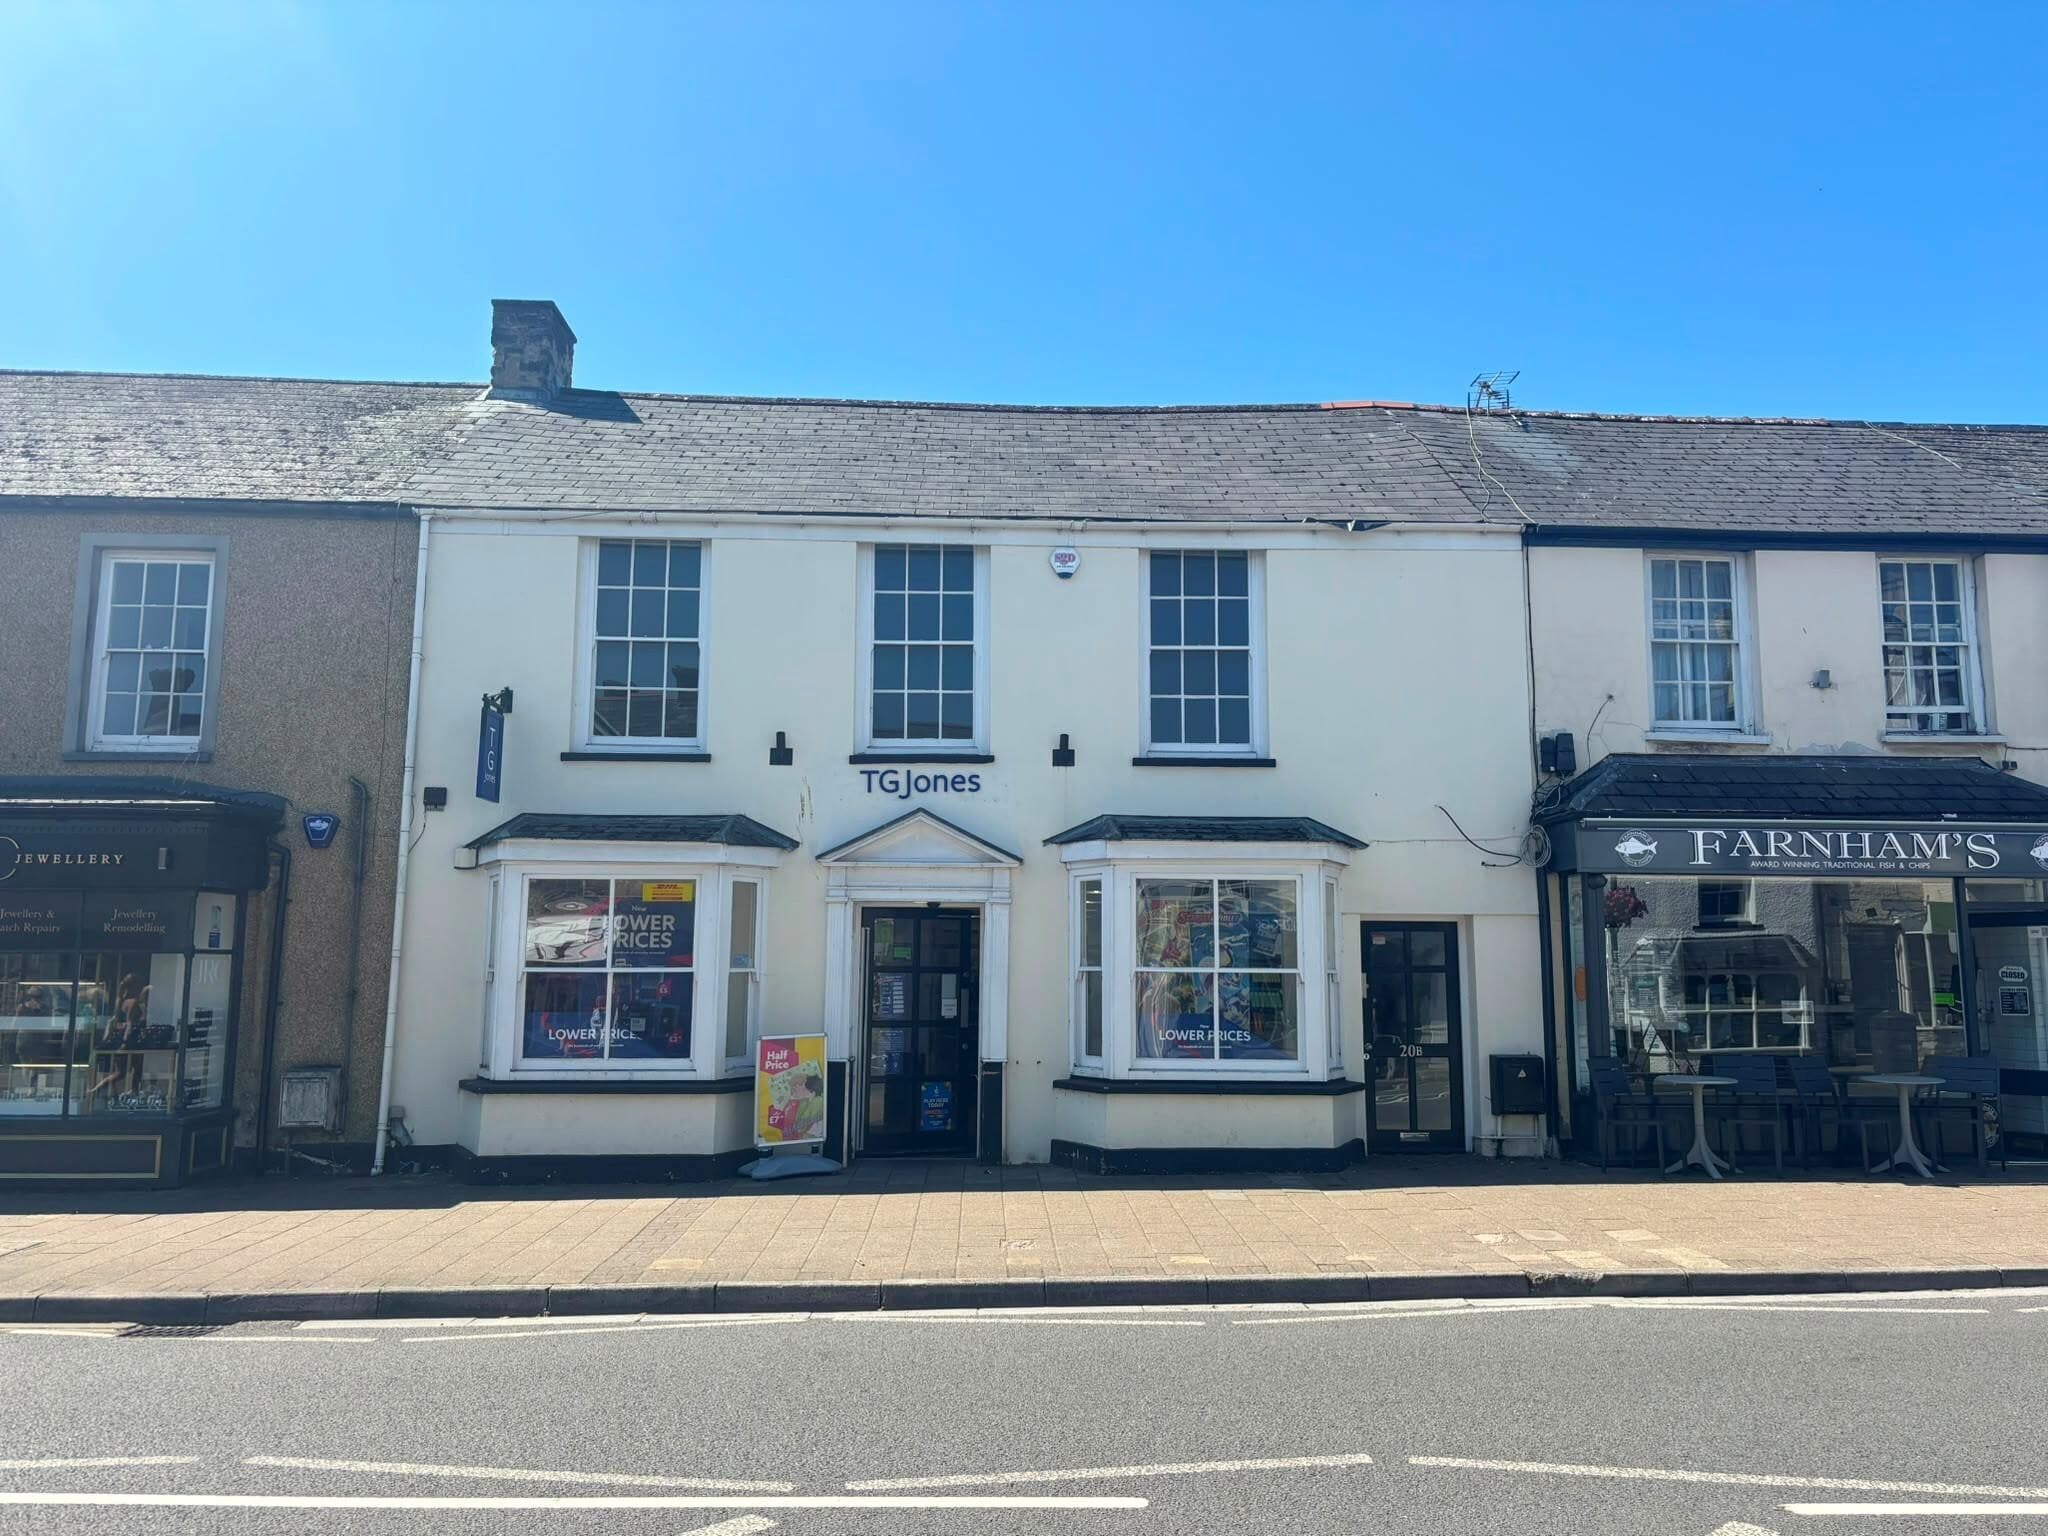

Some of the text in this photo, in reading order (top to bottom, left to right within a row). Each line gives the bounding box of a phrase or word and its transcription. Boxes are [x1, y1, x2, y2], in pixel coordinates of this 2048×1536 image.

[1688, 830, 2000, 869] FARNHAM'S
[15, 854, 124, 865] JEWELLERY
[1782, 861, 1820, 869] WINNING
[1823, 861, 1875, 869] TRADITIONAL
[0, 908, 57, 920] Jewellery &
[111, 908, 158, 920] Jewellery
[24, 922, 61, 935] Repairs
[104, 923, 166, 934] Remodelling
[2001, 971, 2025, 979] CLOSED
[548, 1029, 597, 1040] LOWER
[1159, 1030, 1205, 1041] LOWER
[767, 1050, 788, 1060] Half
[1399, 1044, 1423, 1058] 20B
[765, 1060, 789, 1070] Price
